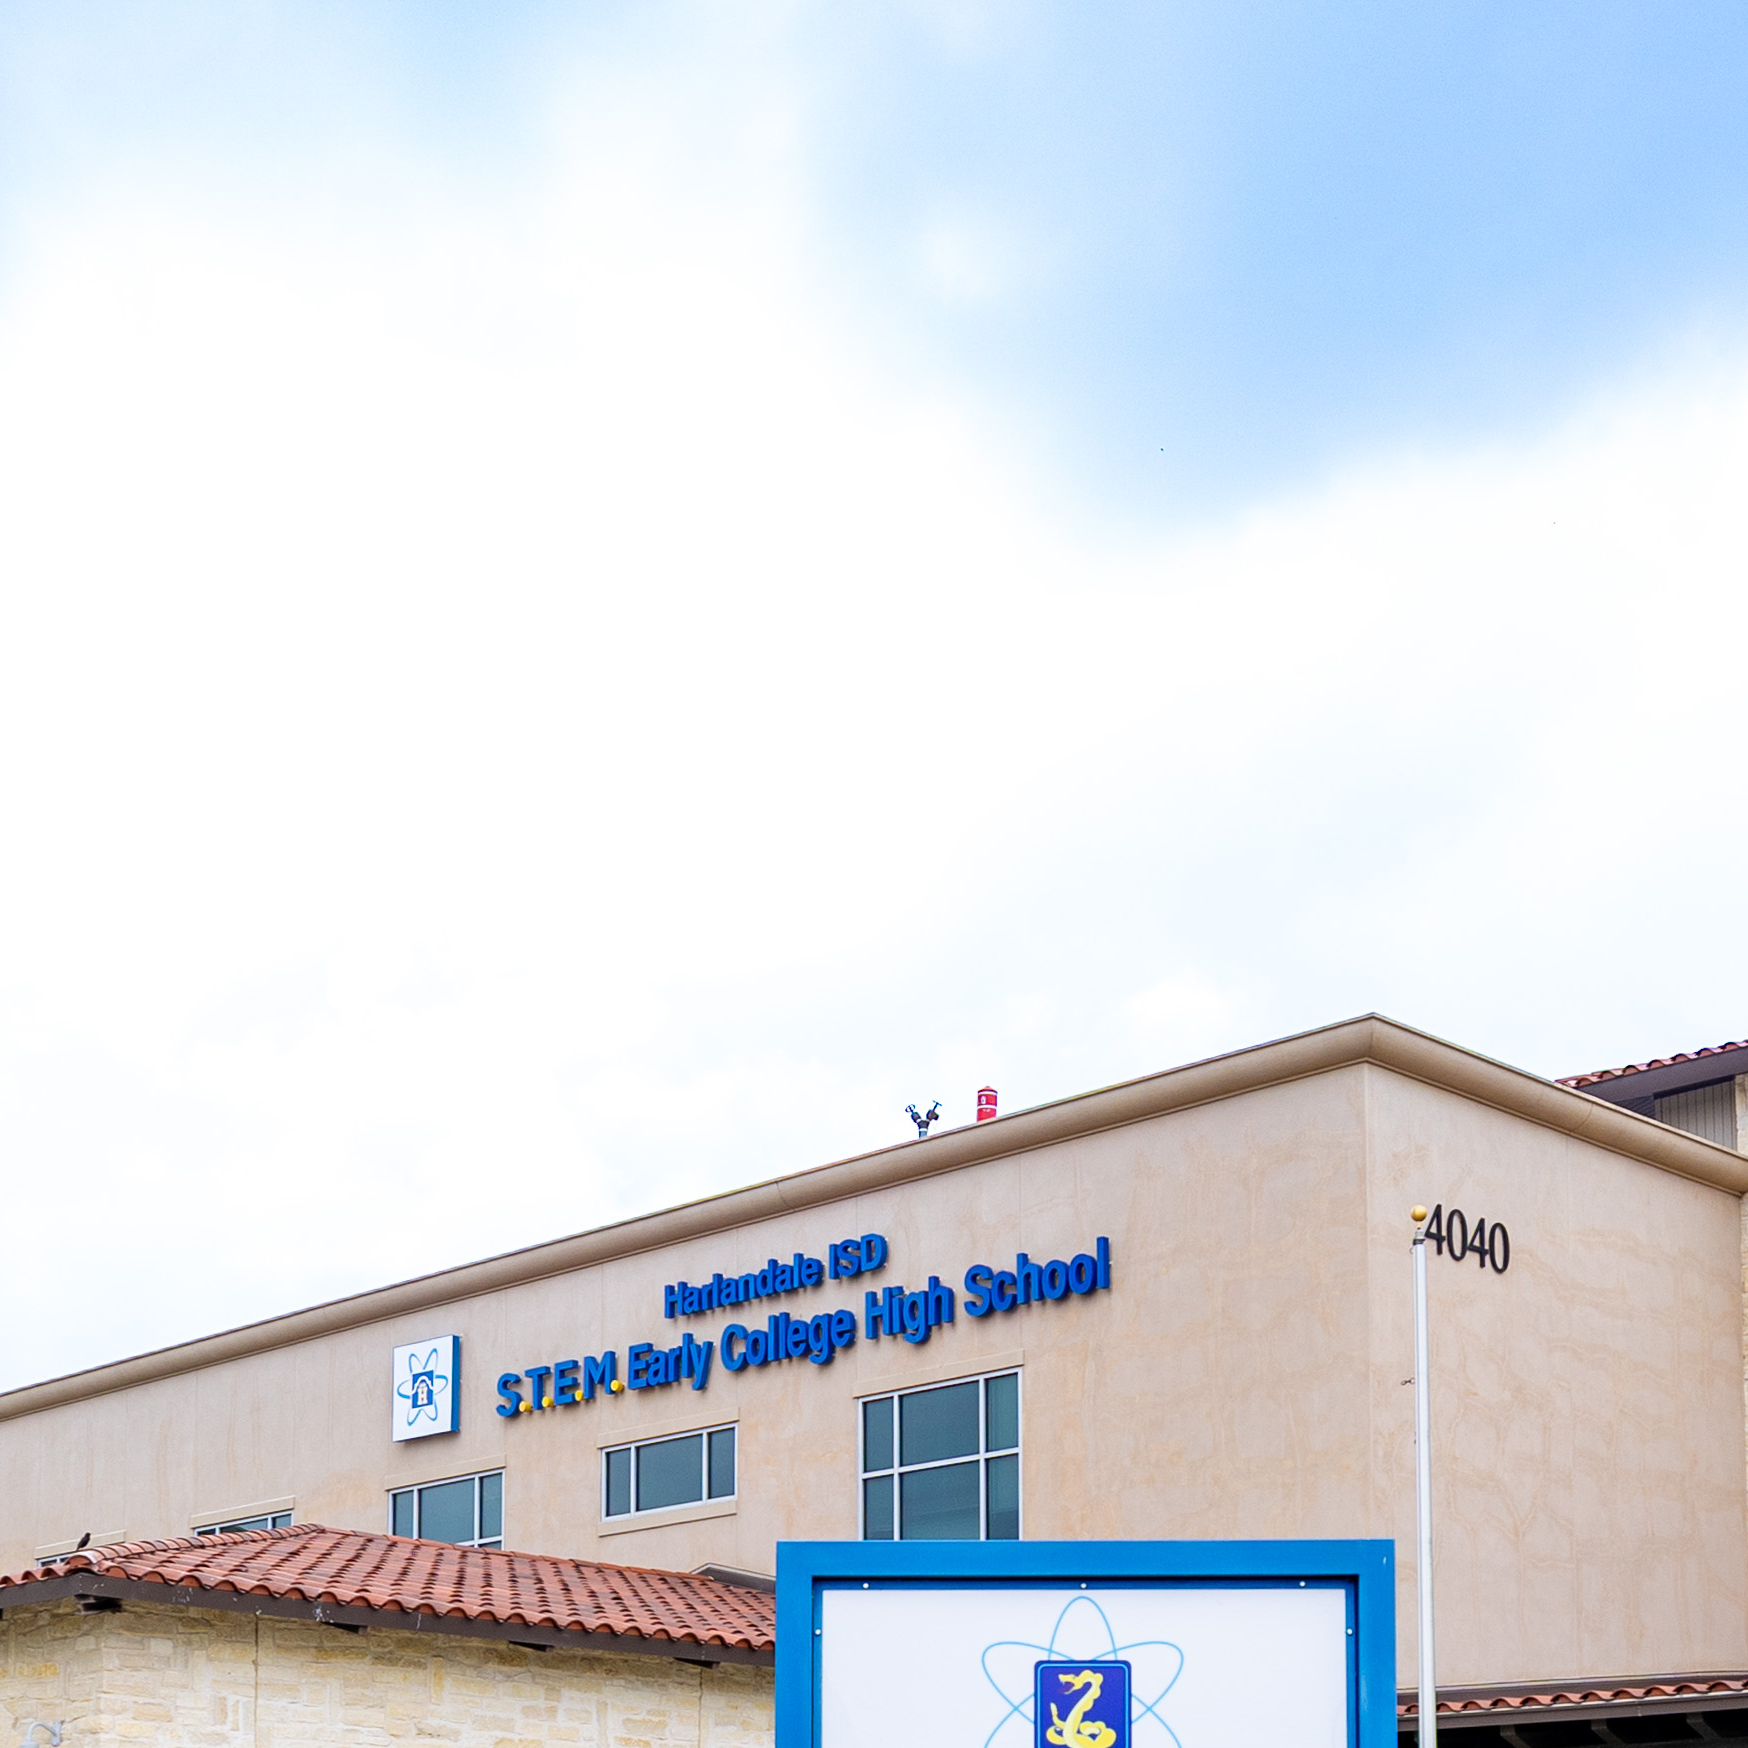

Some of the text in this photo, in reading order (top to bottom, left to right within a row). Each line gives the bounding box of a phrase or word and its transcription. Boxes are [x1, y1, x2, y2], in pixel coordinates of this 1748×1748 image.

[664, 1233, 888, 1318] Harlandale ISD
[1424, 1203, 1510, 1274] 4040
[496, 1236, 1111, 1417] S.T.E.M. Early College High School
